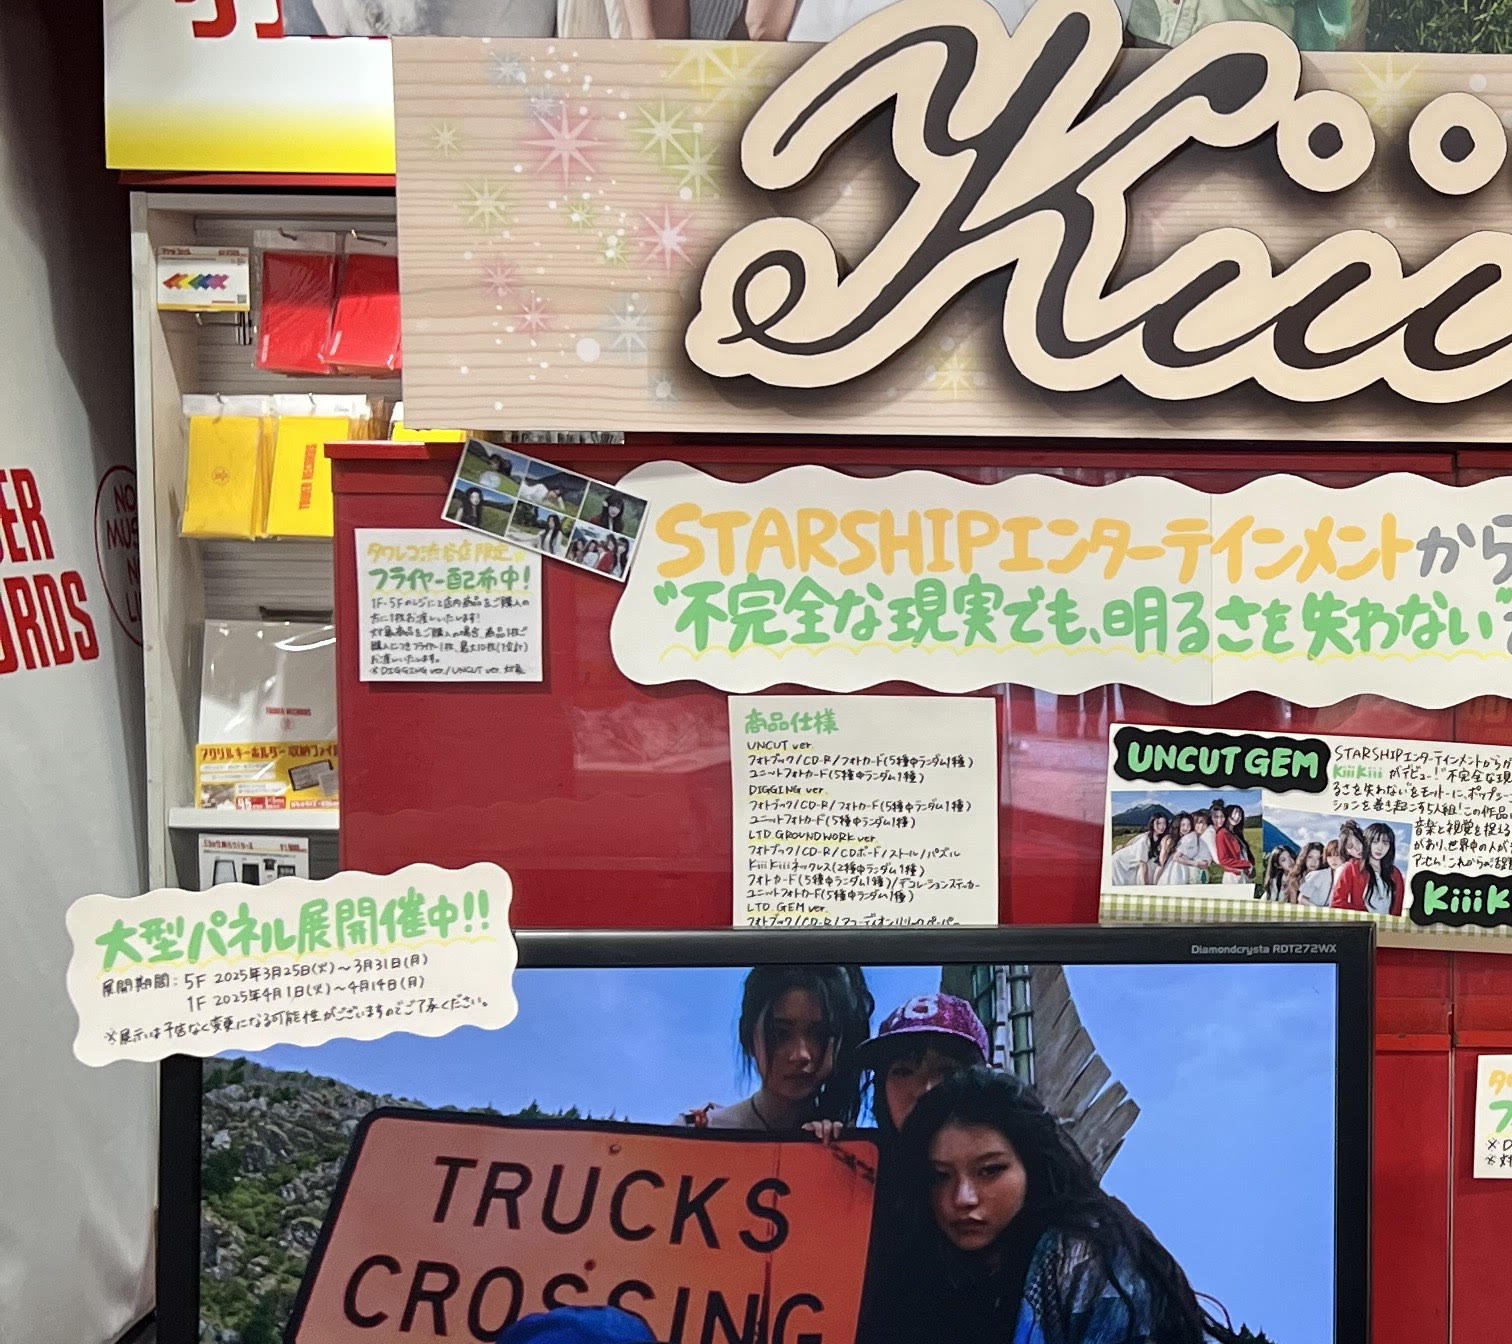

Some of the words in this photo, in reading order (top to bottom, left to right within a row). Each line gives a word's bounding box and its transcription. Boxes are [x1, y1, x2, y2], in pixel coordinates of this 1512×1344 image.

[0, 468, 54, 564] ER
[745, 708, 839, 735] 商品仕様
[747, 740, 788, 751] UNCUT
[1127, 741, 1243, 777] UNCUT
[1246, 746, 1319, 780] GEM
[749, 785, 801, 796] DIGGING
[776, 903, 805, 913] GEM
[95, 886, 489, 971] 大型パネル展開催中!!
[1273, 943, 1338, 954] RDT272WX
[184, 971, 206, 990] 5F
[432, 1156, 792, 1253] TRUCKS
